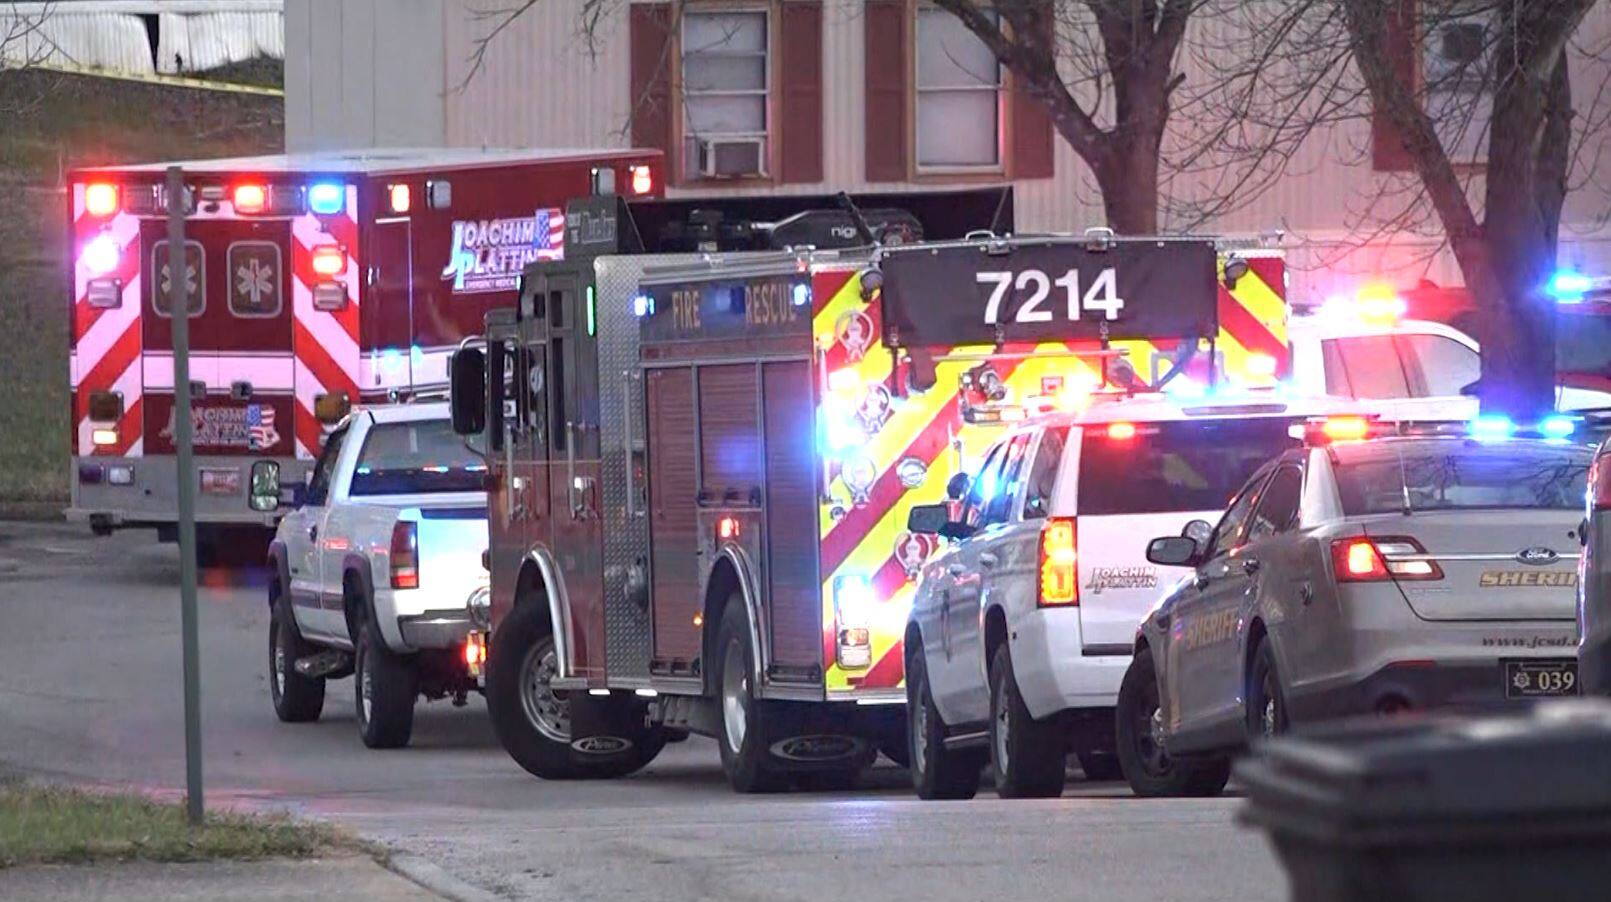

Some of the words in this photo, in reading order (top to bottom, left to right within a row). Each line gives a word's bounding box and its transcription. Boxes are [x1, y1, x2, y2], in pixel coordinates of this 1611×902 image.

[672, 290, 700, 329] FIRE
[745, 283, 797, 326] RESCUE
[976, 268, 1124, 324] 7214
[1526, 549, 1550, 559] Ford
[1085, 567, 1156, 589] JOACHIM
[1538, 672, 1574, 690] 039
